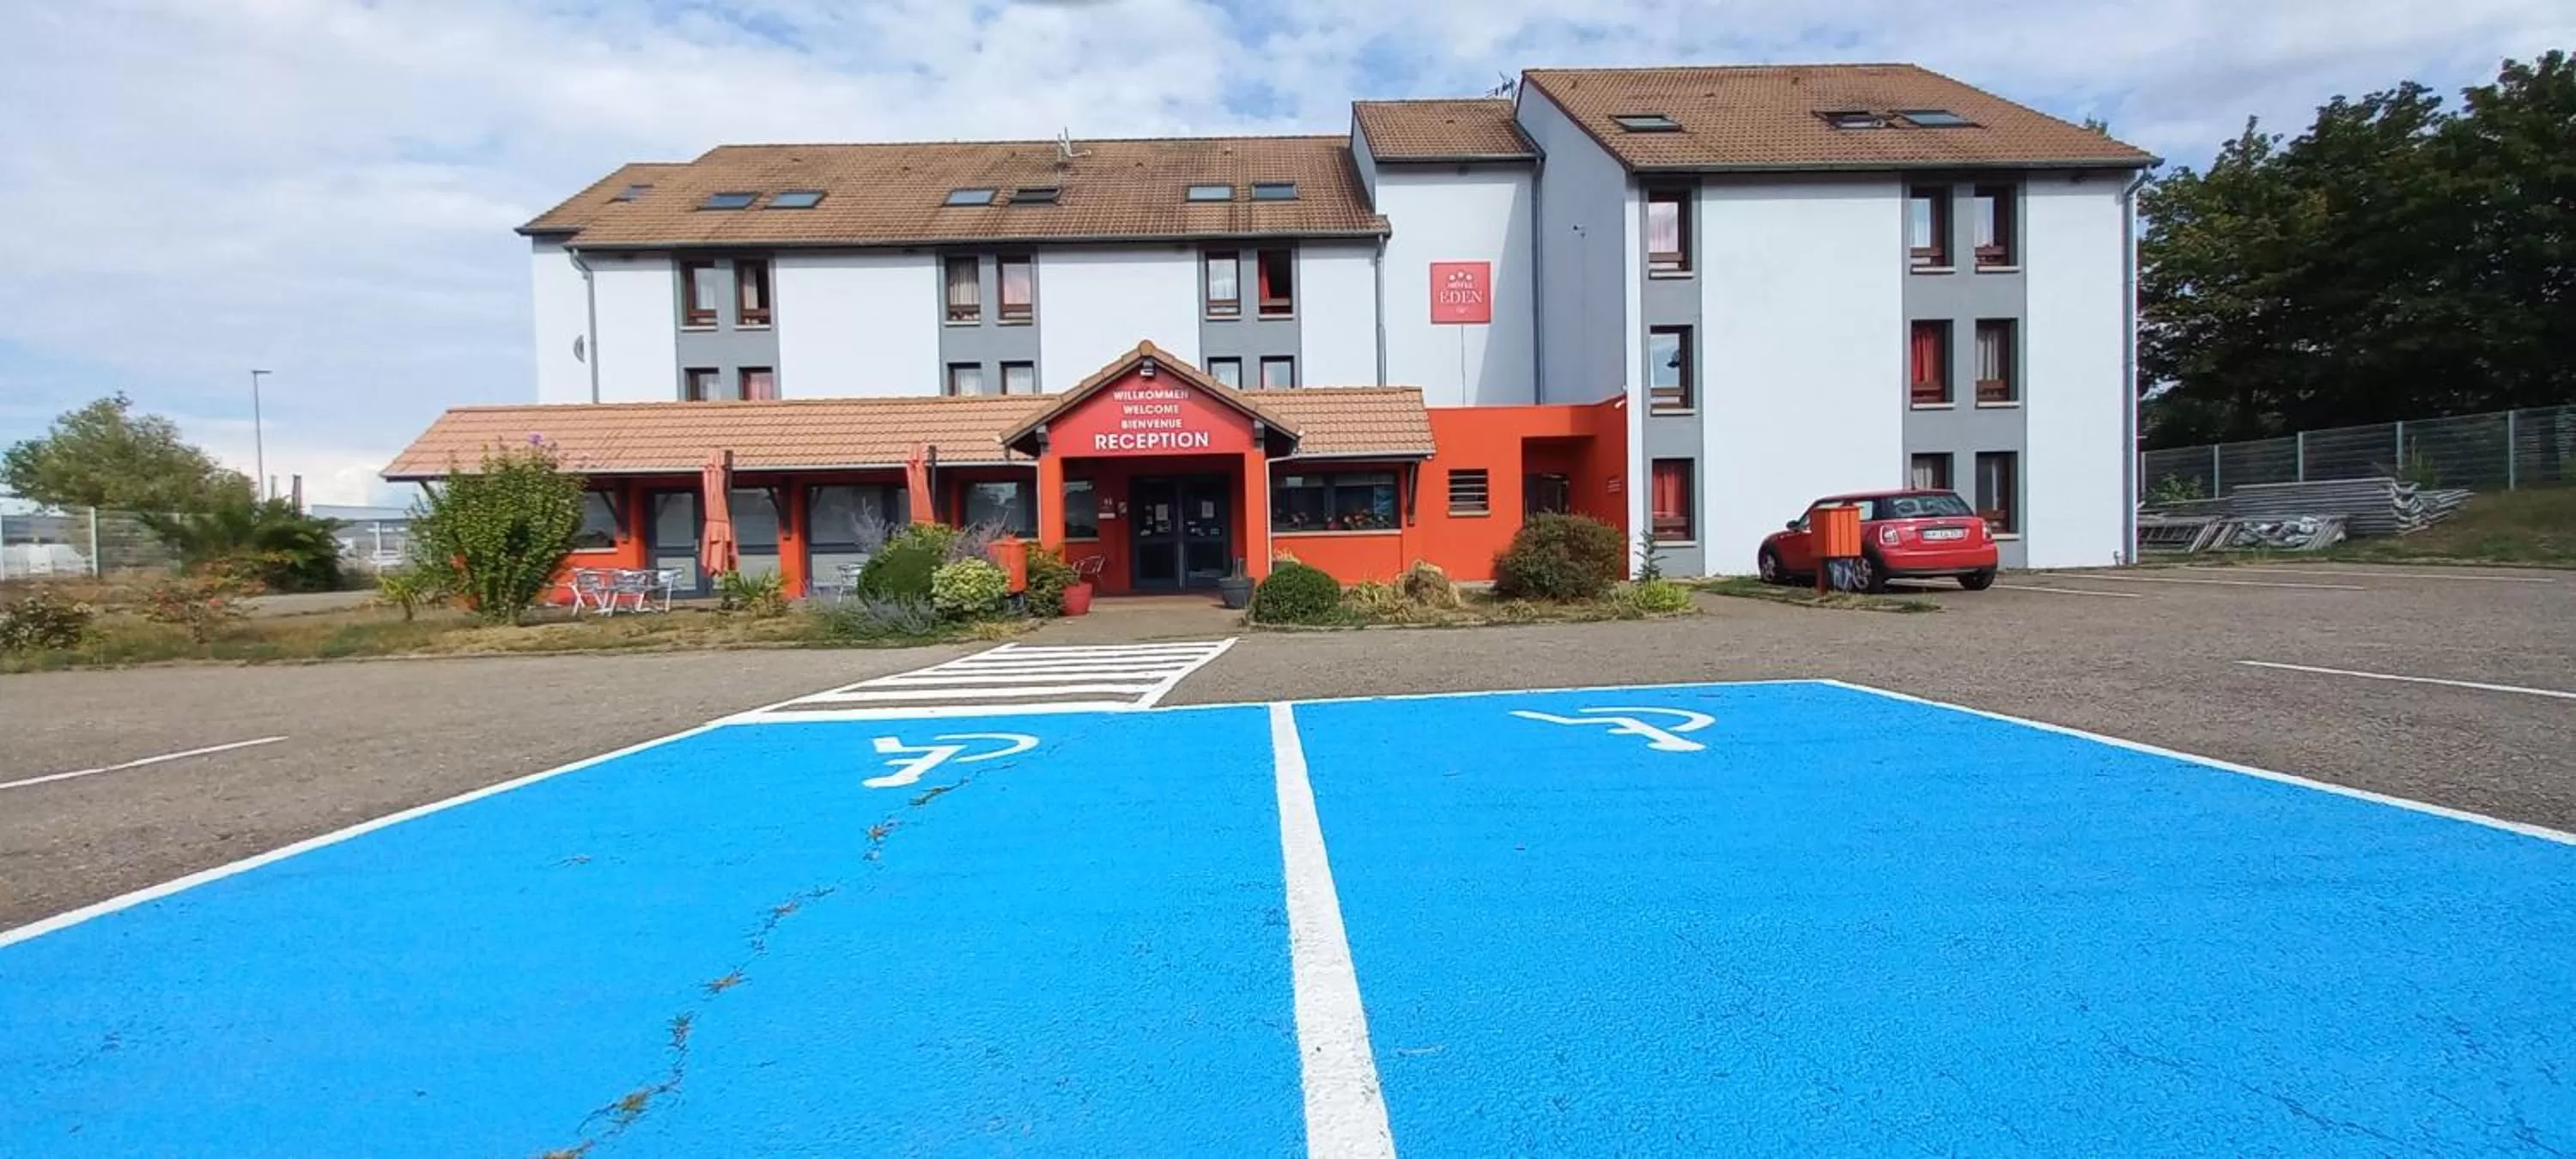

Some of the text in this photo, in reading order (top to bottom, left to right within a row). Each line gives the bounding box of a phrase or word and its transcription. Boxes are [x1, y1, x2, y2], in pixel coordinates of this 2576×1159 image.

[1114, 390, 1189, 400] WILLKOMMEN
[1122, 404, 1180, 414] WELCOME
[1121, 418, 1182, 429] BIENVENUE
[1095, 432, 1209, 450] RECEPTION
